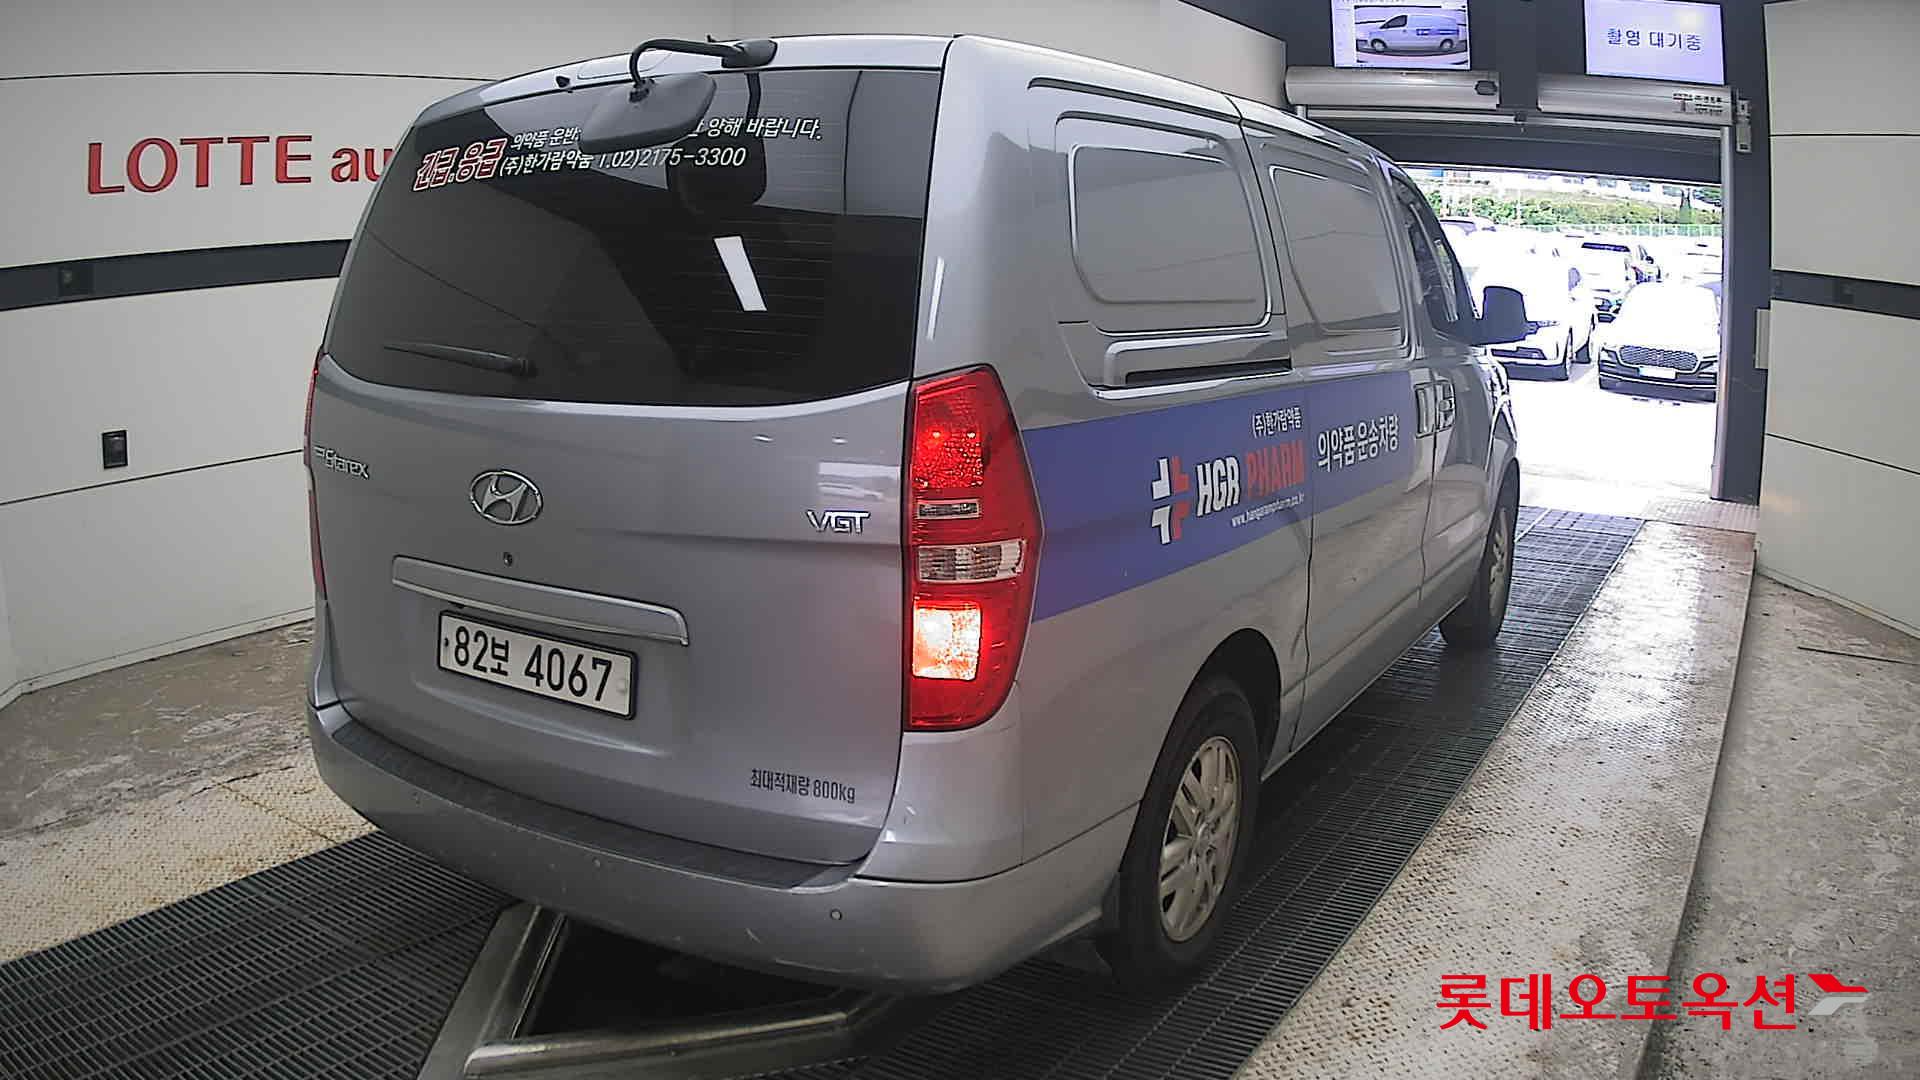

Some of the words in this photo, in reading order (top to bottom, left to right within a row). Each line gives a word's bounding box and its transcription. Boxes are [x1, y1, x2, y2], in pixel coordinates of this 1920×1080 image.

[1649, 31, 1701, 51] 대기중
[548, 127, 582, 146] 운반
[707, 118, 743, 137] 양해
[746, 118, 822, 140] 바랍니다.
[88, 135, 312, 194] LOTTE
[1196, 456, 1240, 517] HGR
[1247, 439, 1305, 498] PHARM
[805, 510, 871, 534] VGT
[454, 625, 509, 677] 82보
[524, 644, 613, 702] 4067
[750, 769, 810, 797] 최대적재량
